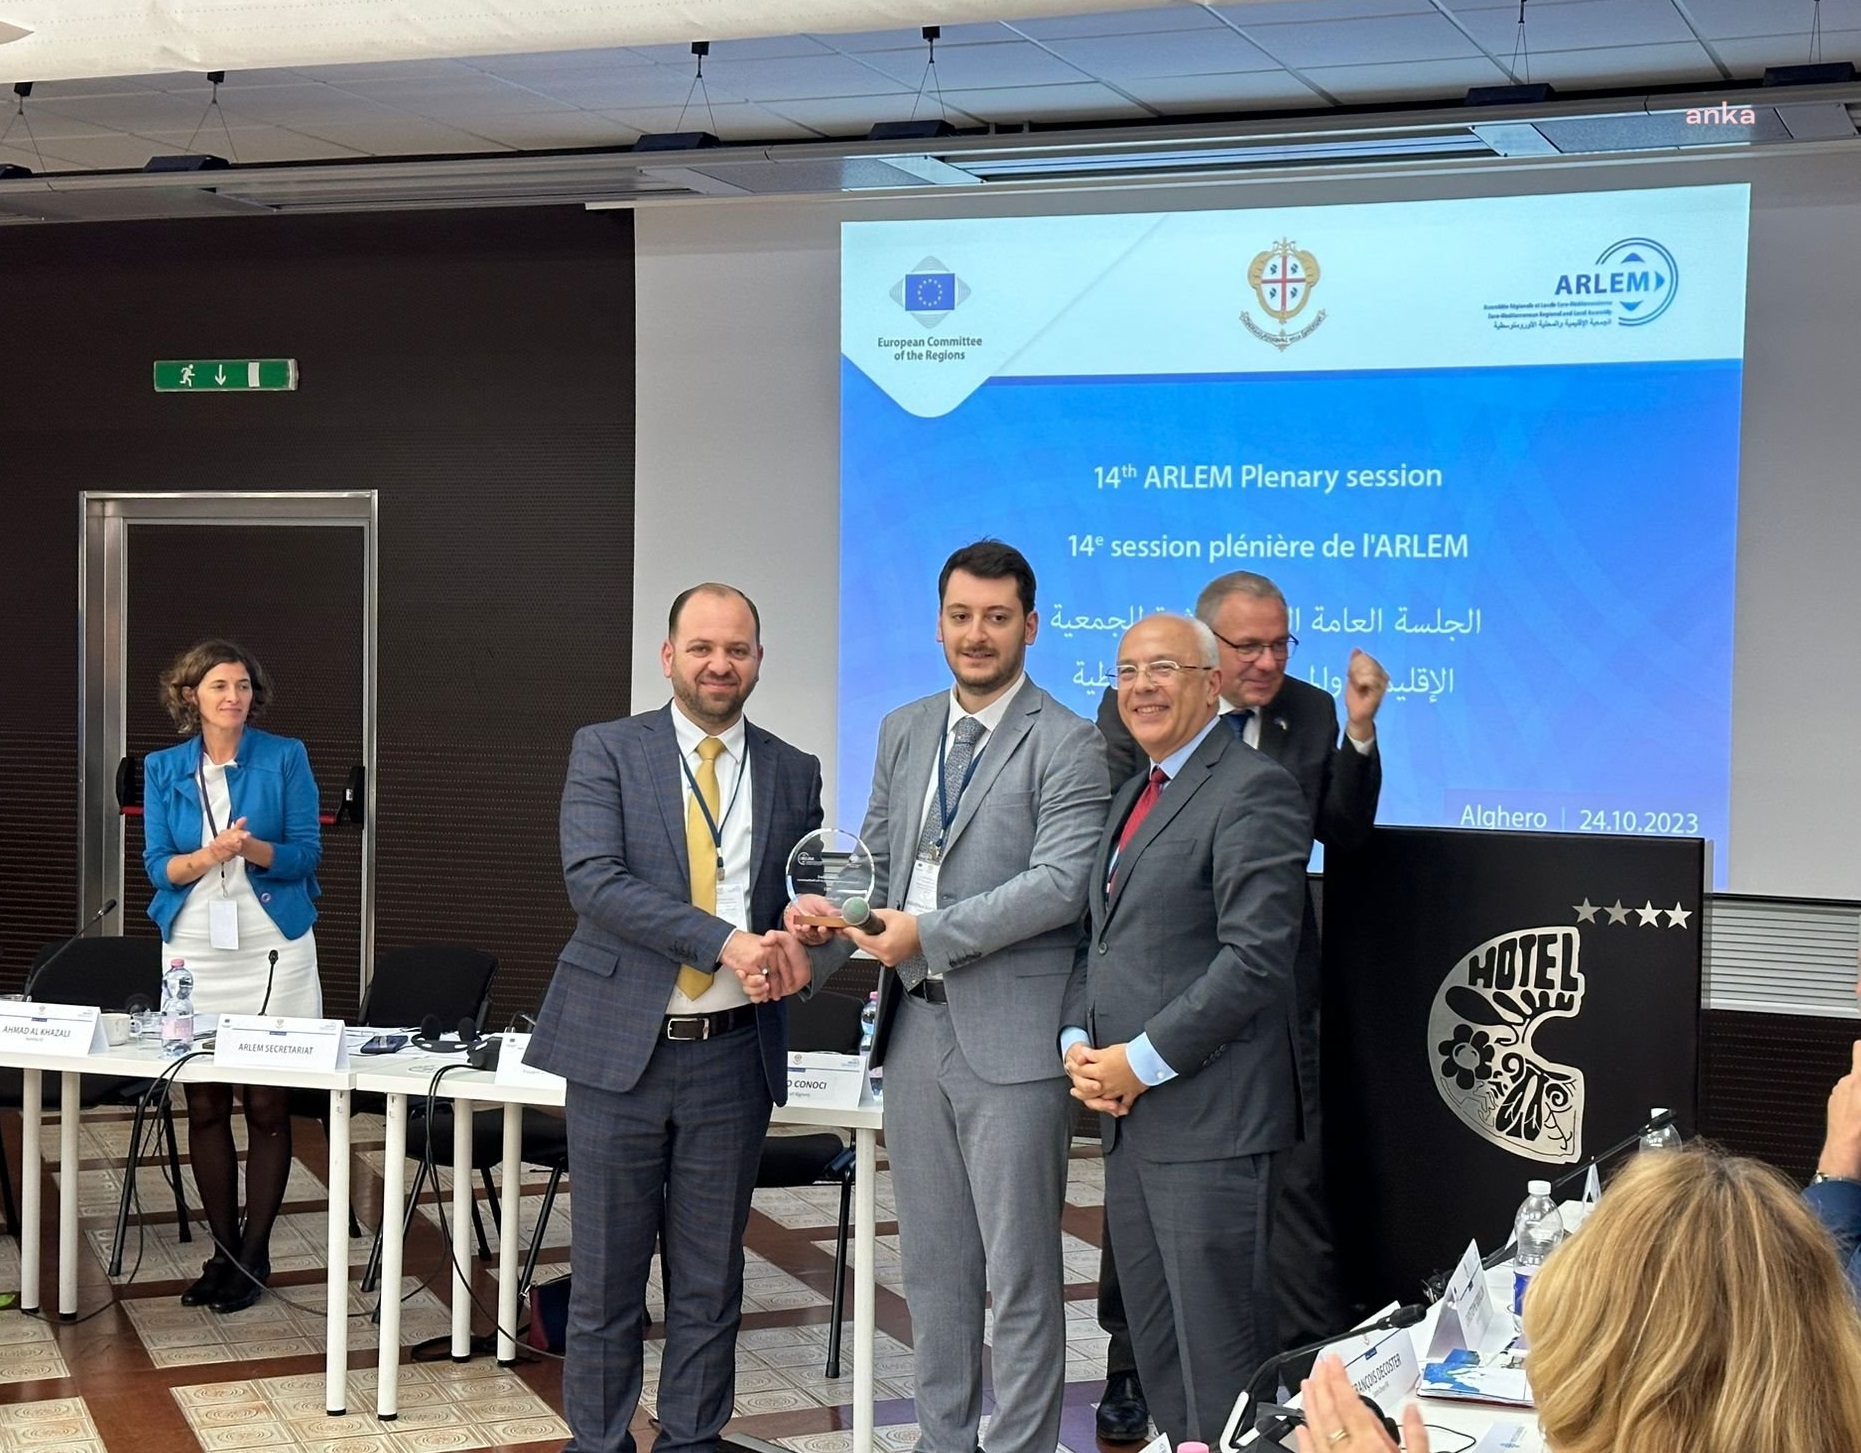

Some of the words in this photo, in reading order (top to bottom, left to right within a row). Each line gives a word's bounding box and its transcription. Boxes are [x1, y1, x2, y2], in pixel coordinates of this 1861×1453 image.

[1554, 271, 1650, 295] ARLEM
[877, 337, 925, 349] European
[927, 336, 982, 347] Committee
[894, 350, 905, 361] of
[907, 350, 923, 360] the
[925, 349, 965, 362] Regions
[1143, 465, 1232, 489] ARLEM
[1240, 463, 1339, 494] Plenary
[1346, 463, 1443, 487] session
[1110, 534, 1200, 557] session
[1209, 532, 1315, 563] plénière
[1322, 533, 1355, 557] de
[1363, 533, 1468, 558] l'ARLEM
[1311, 605, 1383, 633] العامة
[1394, 606, 1481, 641] الجلسة
[1460, 804, 1547, 829] Alghero
[1579, 809, 1699, 834] 24.10.2023
[1468, 932, 1579, 991] HOTEL
[2, 1025, 30, 1034] AHMAD
[30, 1027, 39, 1035] AL
[40, 1028, 71, 1038] KHAZALI
[238, 1043, 264, 1052] ARLEM
[265, 1044, 314, 1055] SECRETARIAT
[794, 1080, 827, 1090] CONOCI
